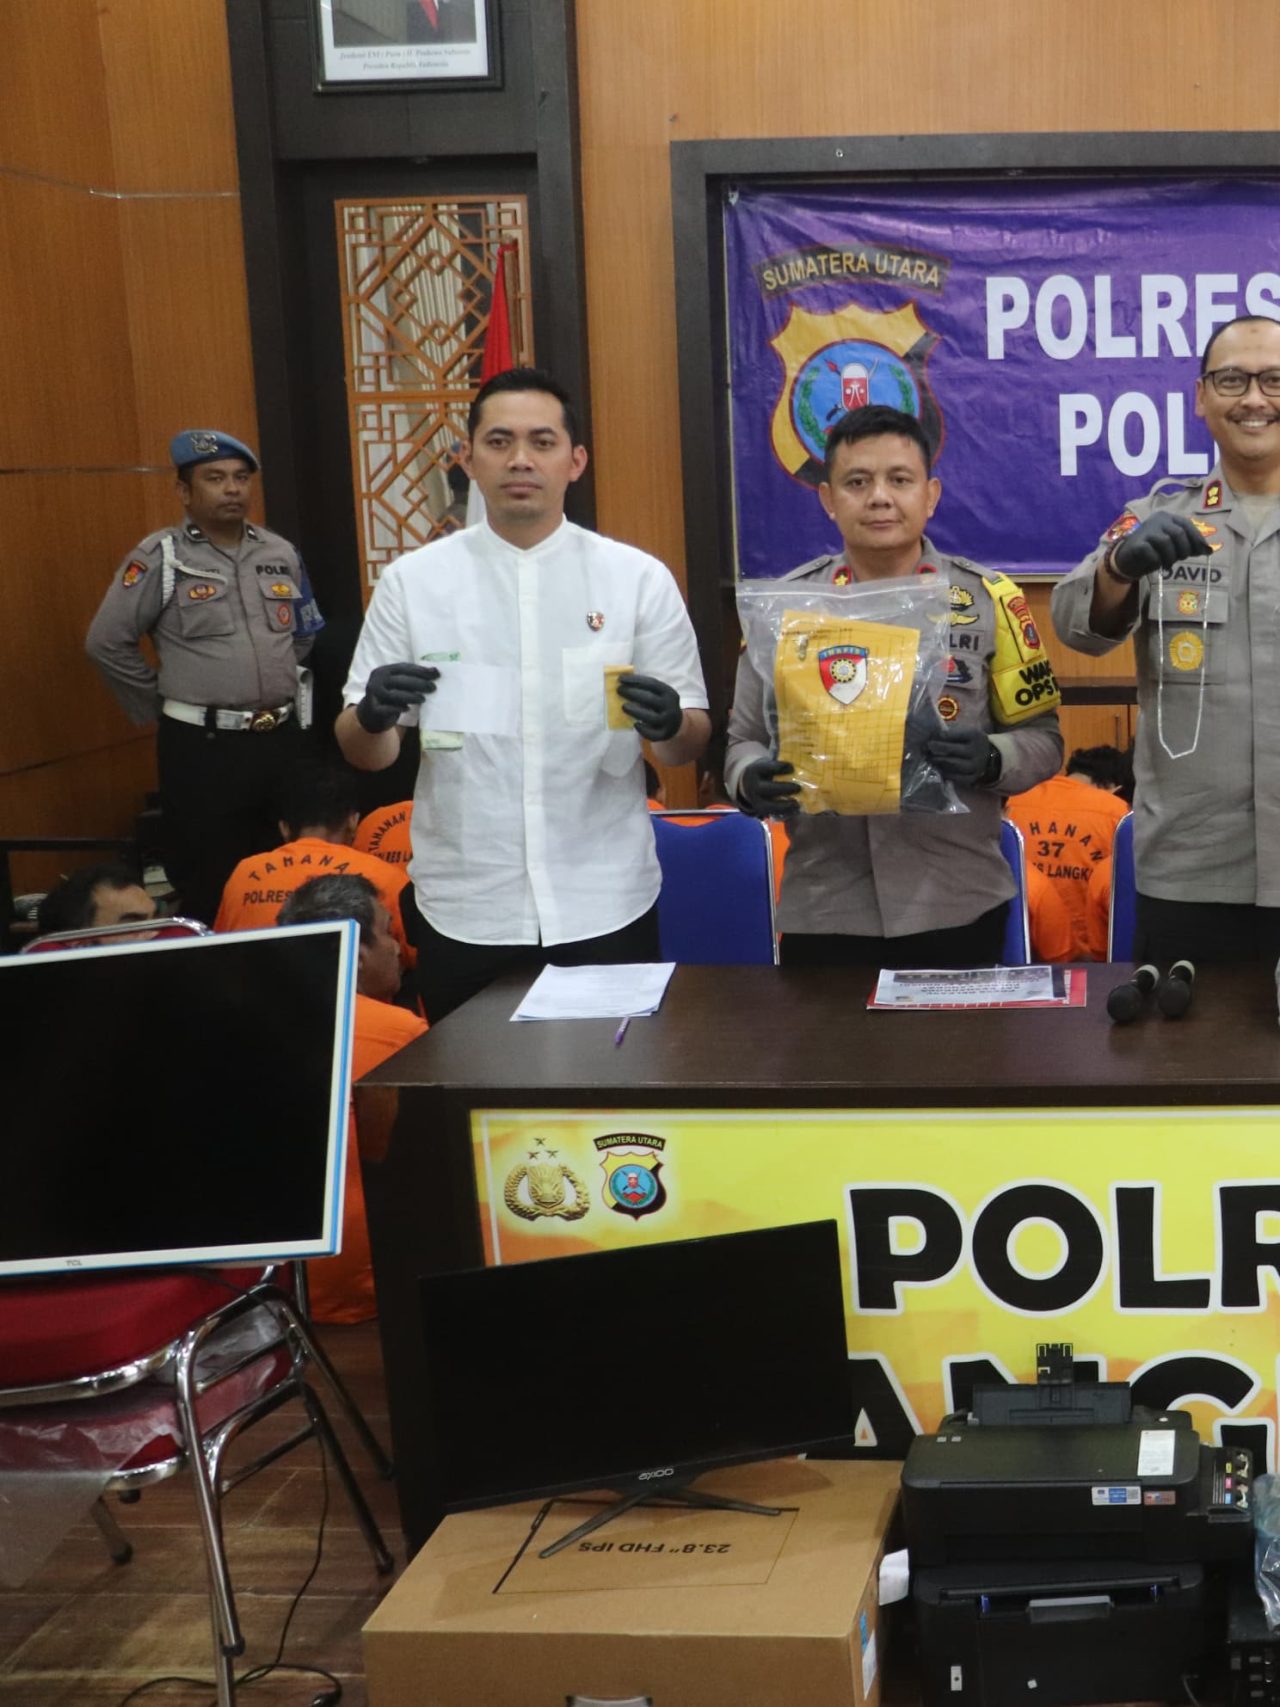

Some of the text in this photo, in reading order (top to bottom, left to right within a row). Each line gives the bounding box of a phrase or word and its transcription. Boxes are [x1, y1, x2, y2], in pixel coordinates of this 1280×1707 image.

[763, 253, 941, 290] SUMATERA UTARA
[949, 633, 980, 651] LRI
[1029, 821, 1103, 862] HANAN
[1037, 841, 1065, 858] 37
[248, 854, 351, 881] TAHANA
[597, 1135, 662, 1148] SUMATERA UTARA
[578, 1542, 615, 1552] IPS
[618, 1542, 665, 1553] FHD
